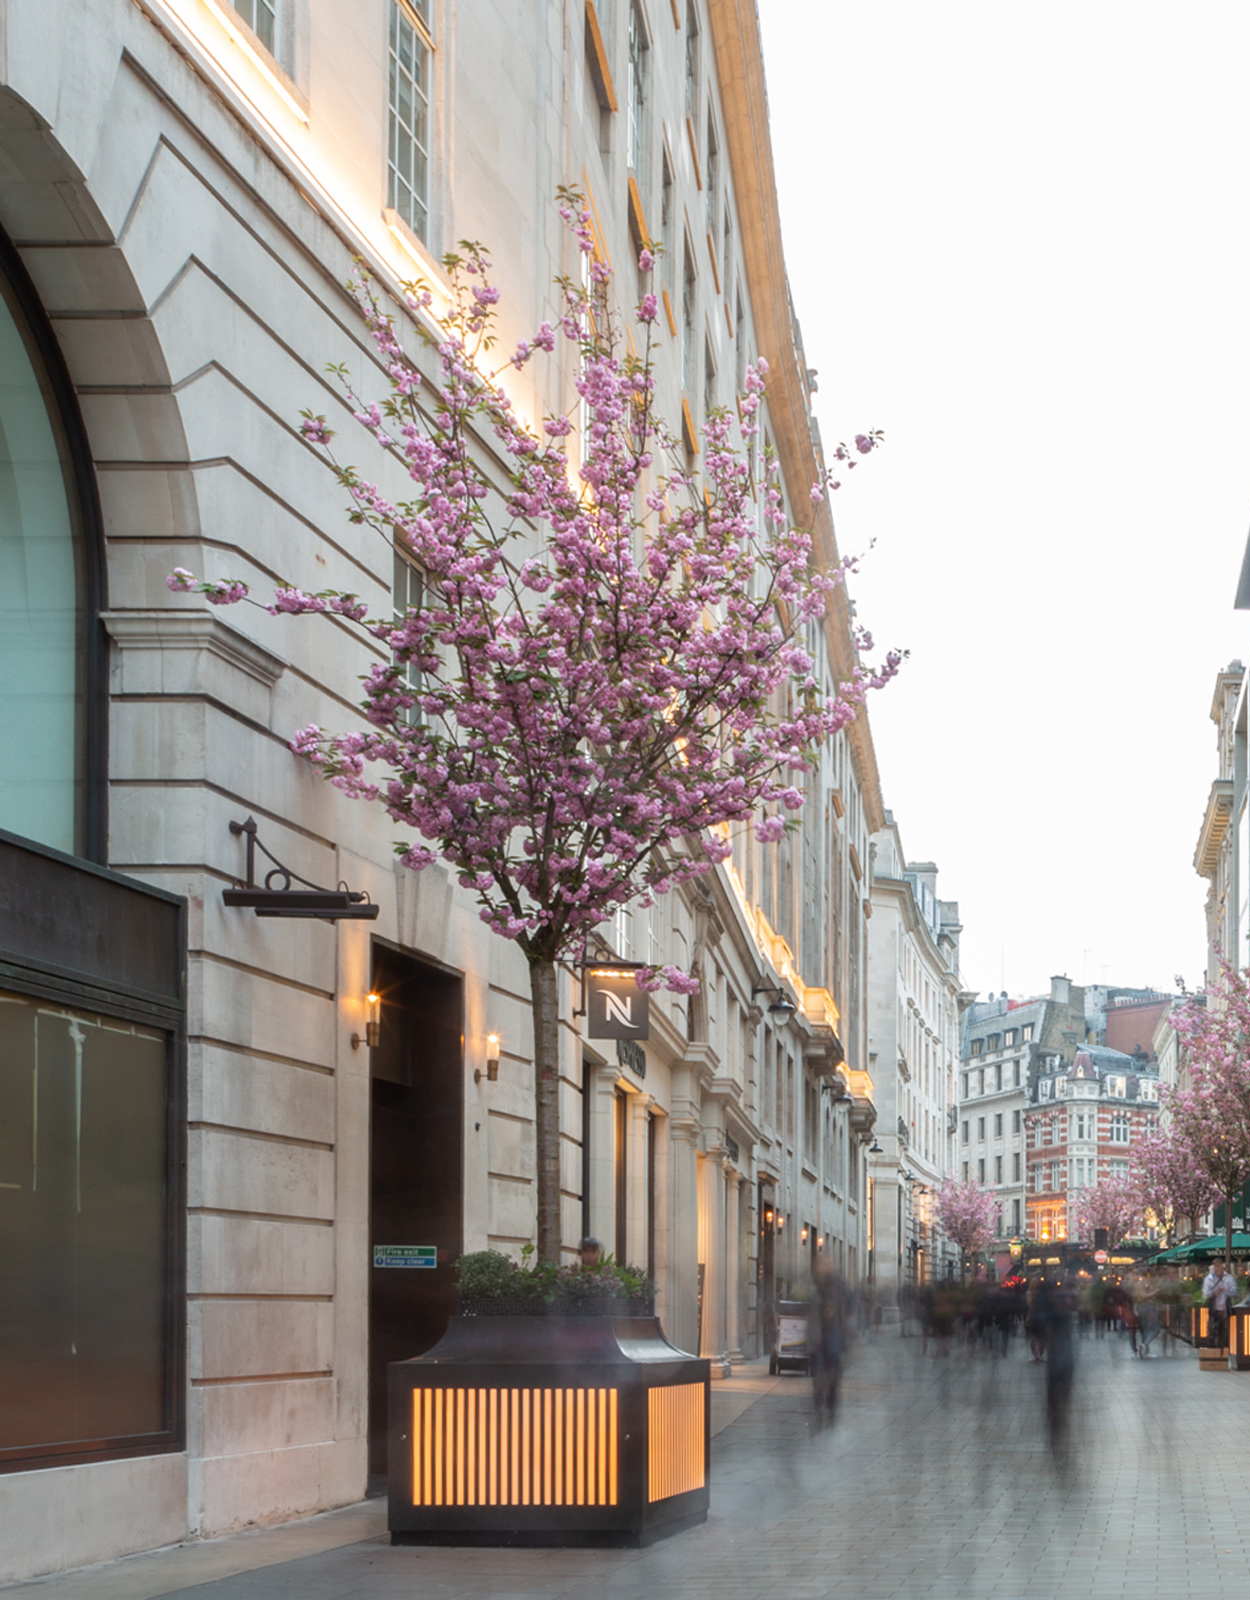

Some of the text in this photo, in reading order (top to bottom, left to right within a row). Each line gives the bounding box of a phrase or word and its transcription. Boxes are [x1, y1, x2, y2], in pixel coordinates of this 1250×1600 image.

[597, 989, 640, 1029] N
[387, 1247, 402, 1256] Fire
[387, 1258, 405, 1266] Keep
